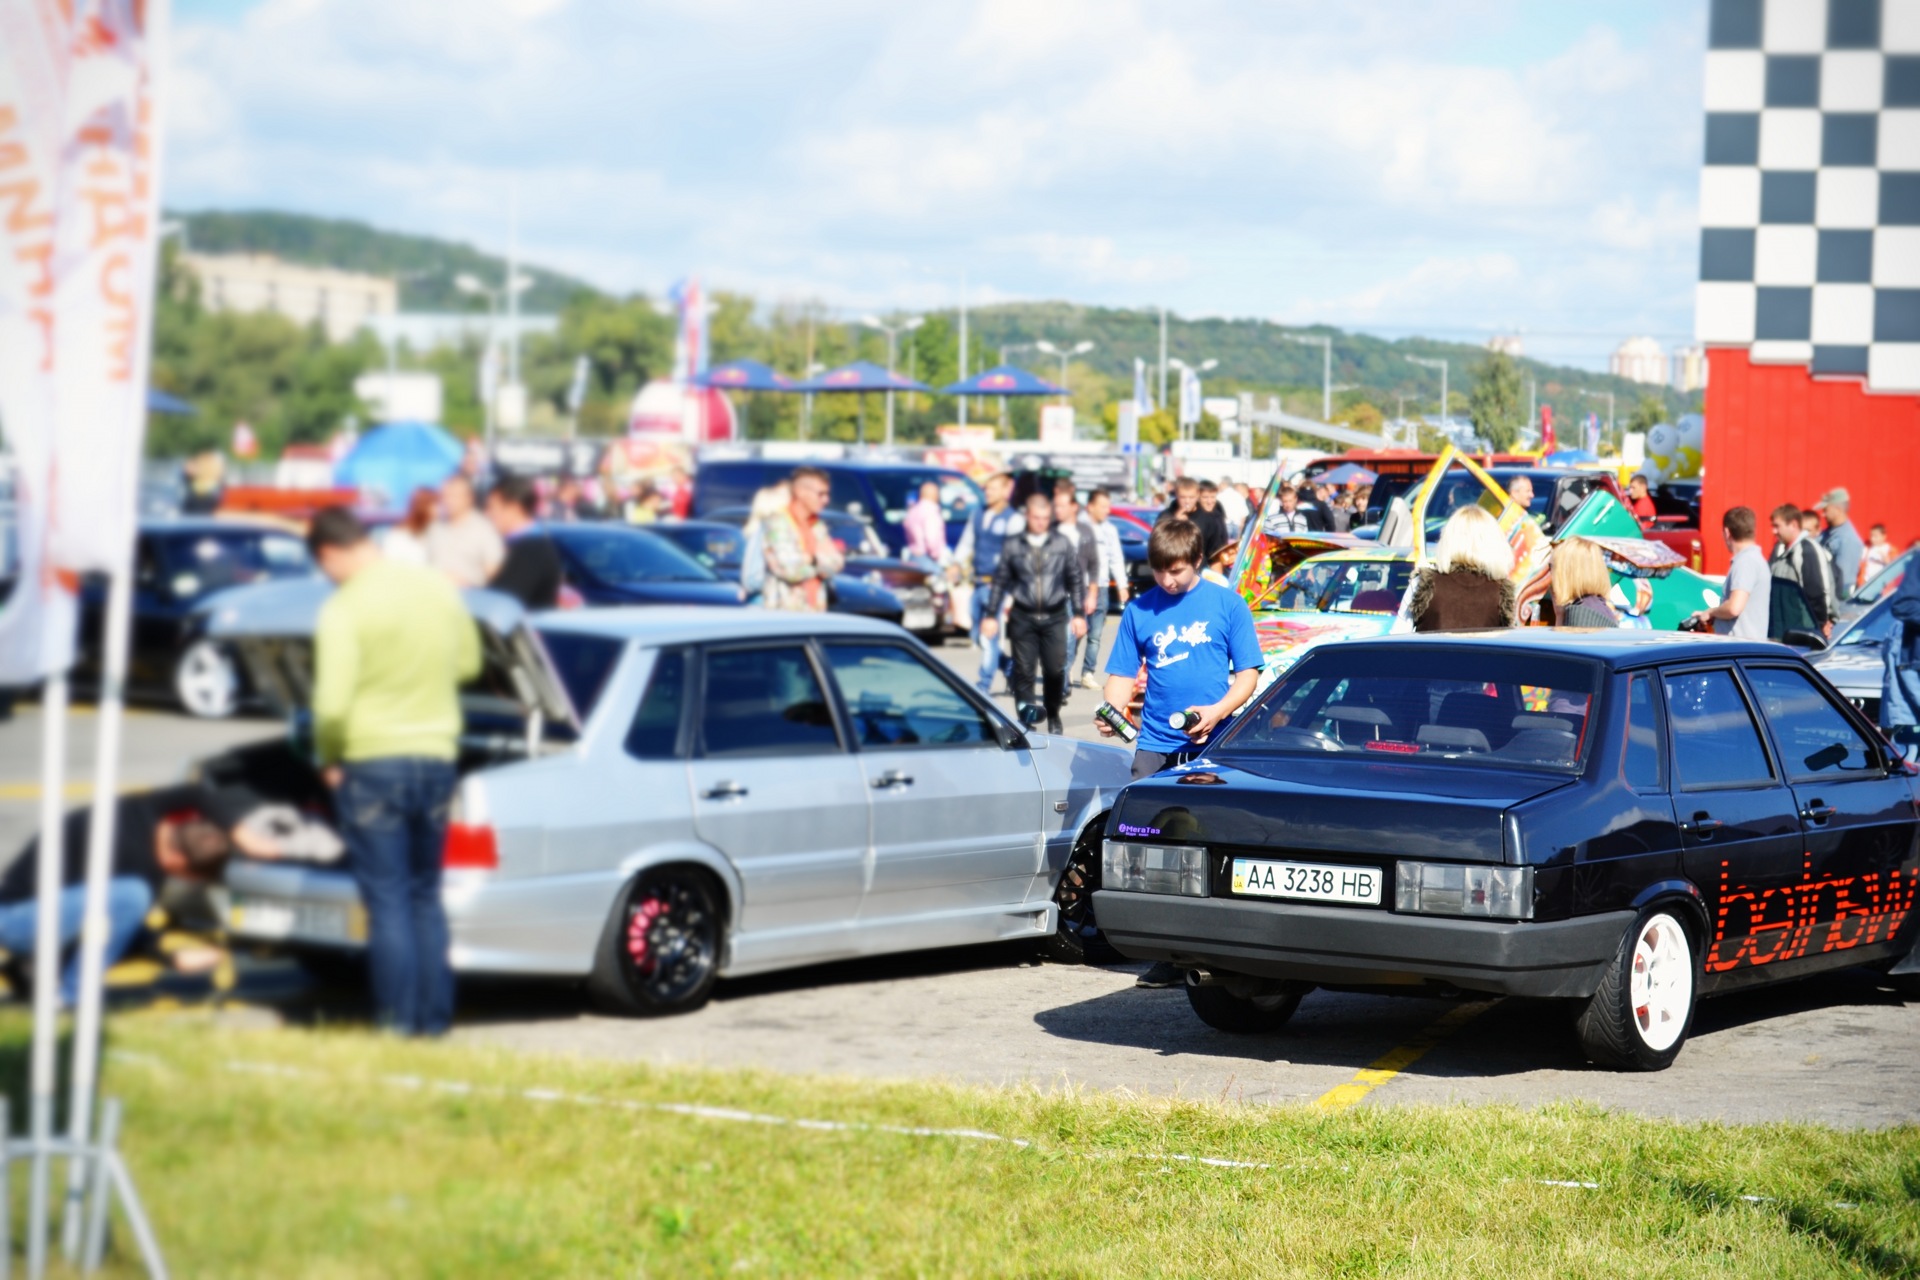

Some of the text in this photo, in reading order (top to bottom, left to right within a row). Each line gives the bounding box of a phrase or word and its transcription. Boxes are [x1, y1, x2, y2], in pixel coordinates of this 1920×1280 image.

[1247, 864, 1373, 898] AA 3238 HB
